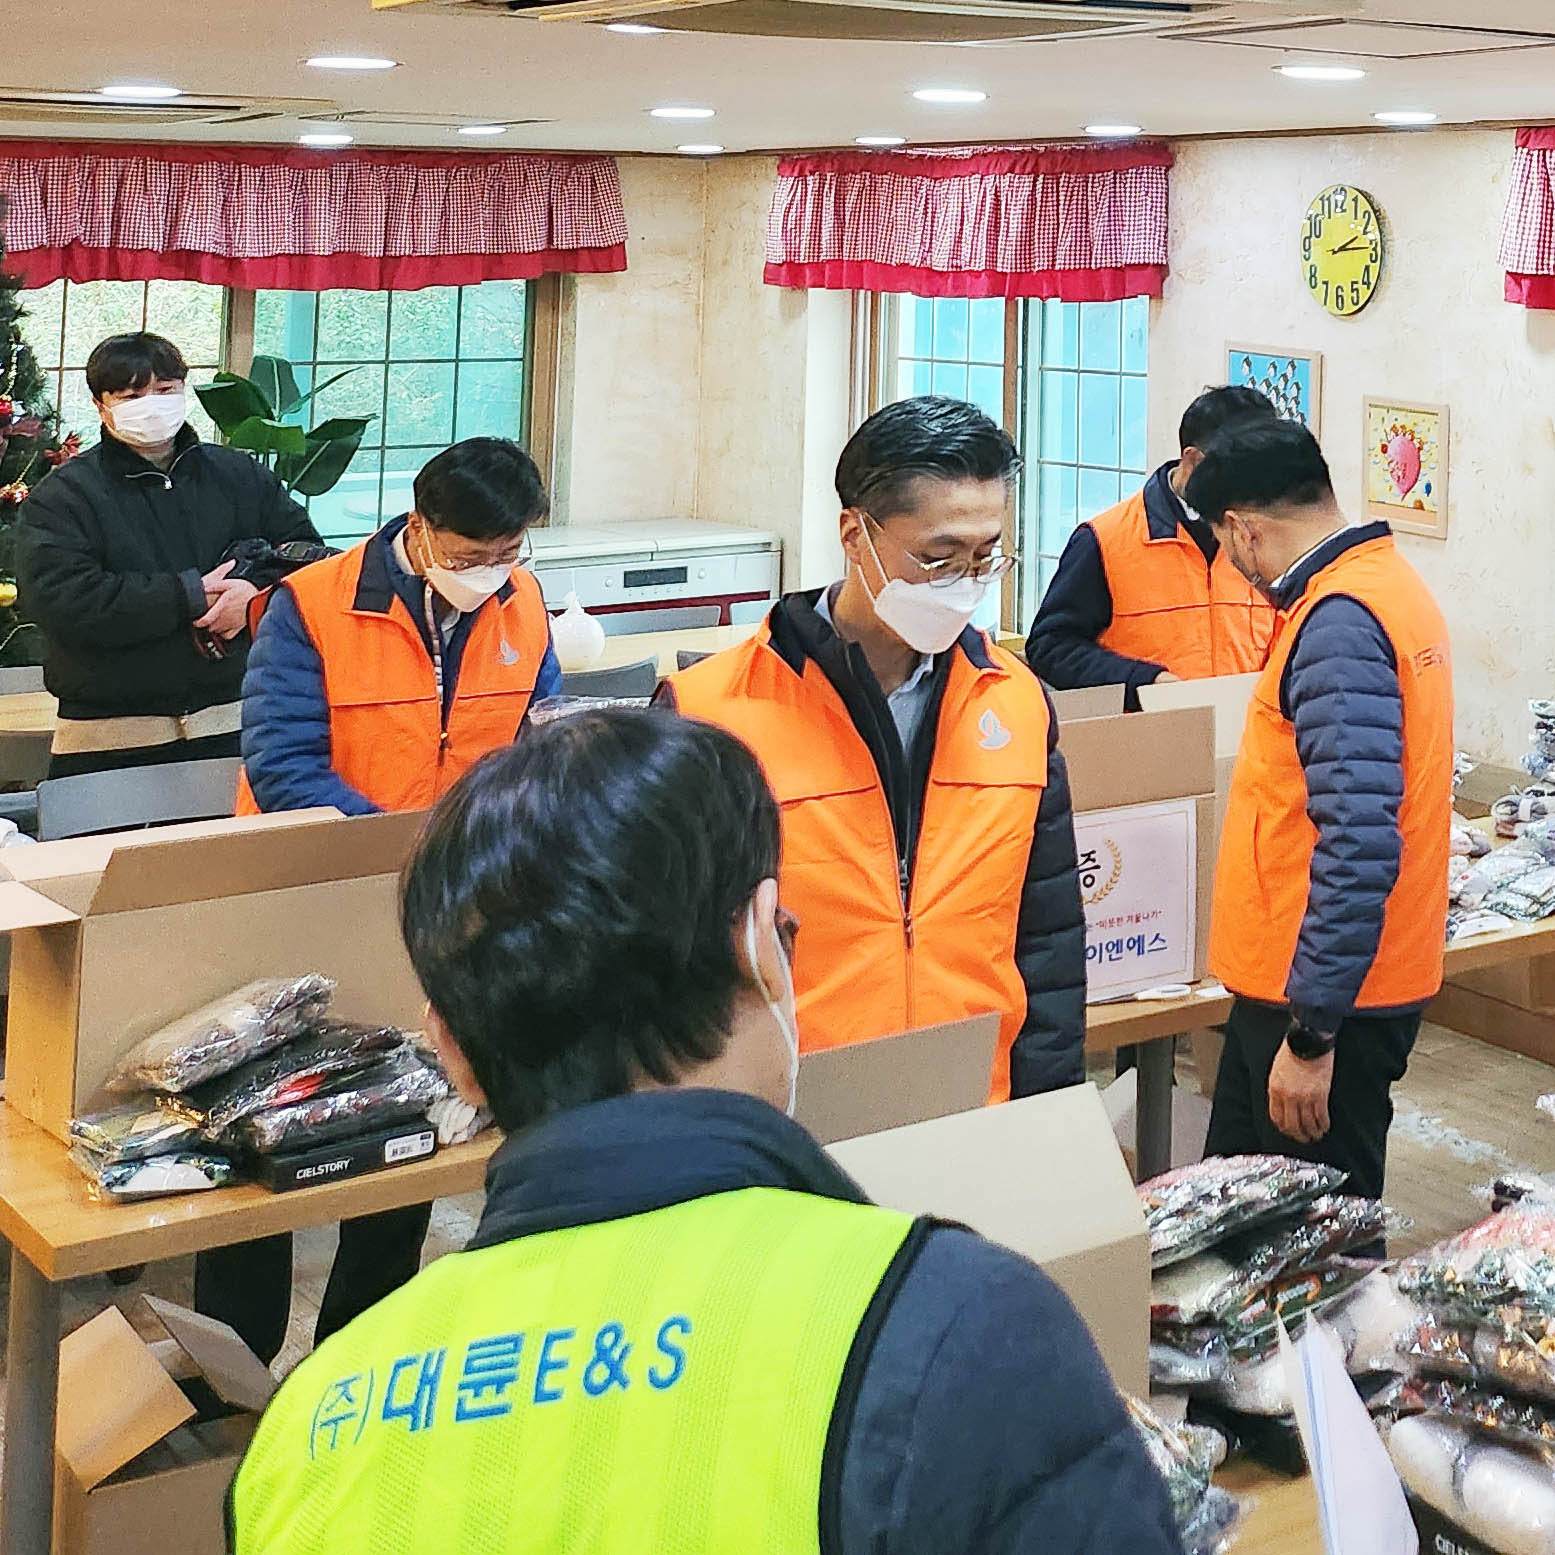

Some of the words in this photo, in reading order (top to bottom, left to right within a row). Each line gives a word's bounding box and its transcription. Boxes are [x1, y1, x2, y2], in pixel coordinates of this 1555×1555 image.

[1319, 194, 1332, 219] 11
[1352, 194, 1359, 220] 1
[1307, 213, 1321, 238] 10
[1362, 210, 1371, 235] 2
[1303, 236, 1311, 261] 9
[1369, 237, 1378, 263] 3
[1309, 264, 1317, 289] 8
[1362, 265, 1371, 290] 4
[1322, 280, 1329, 306] 7
[1335, 285, 1344, 311] 6
[1350, 280, 1359, 306] 5
[1078, 850, 1101, 888] 증
[296, 1158, 351, 1180] CIELSTORY
